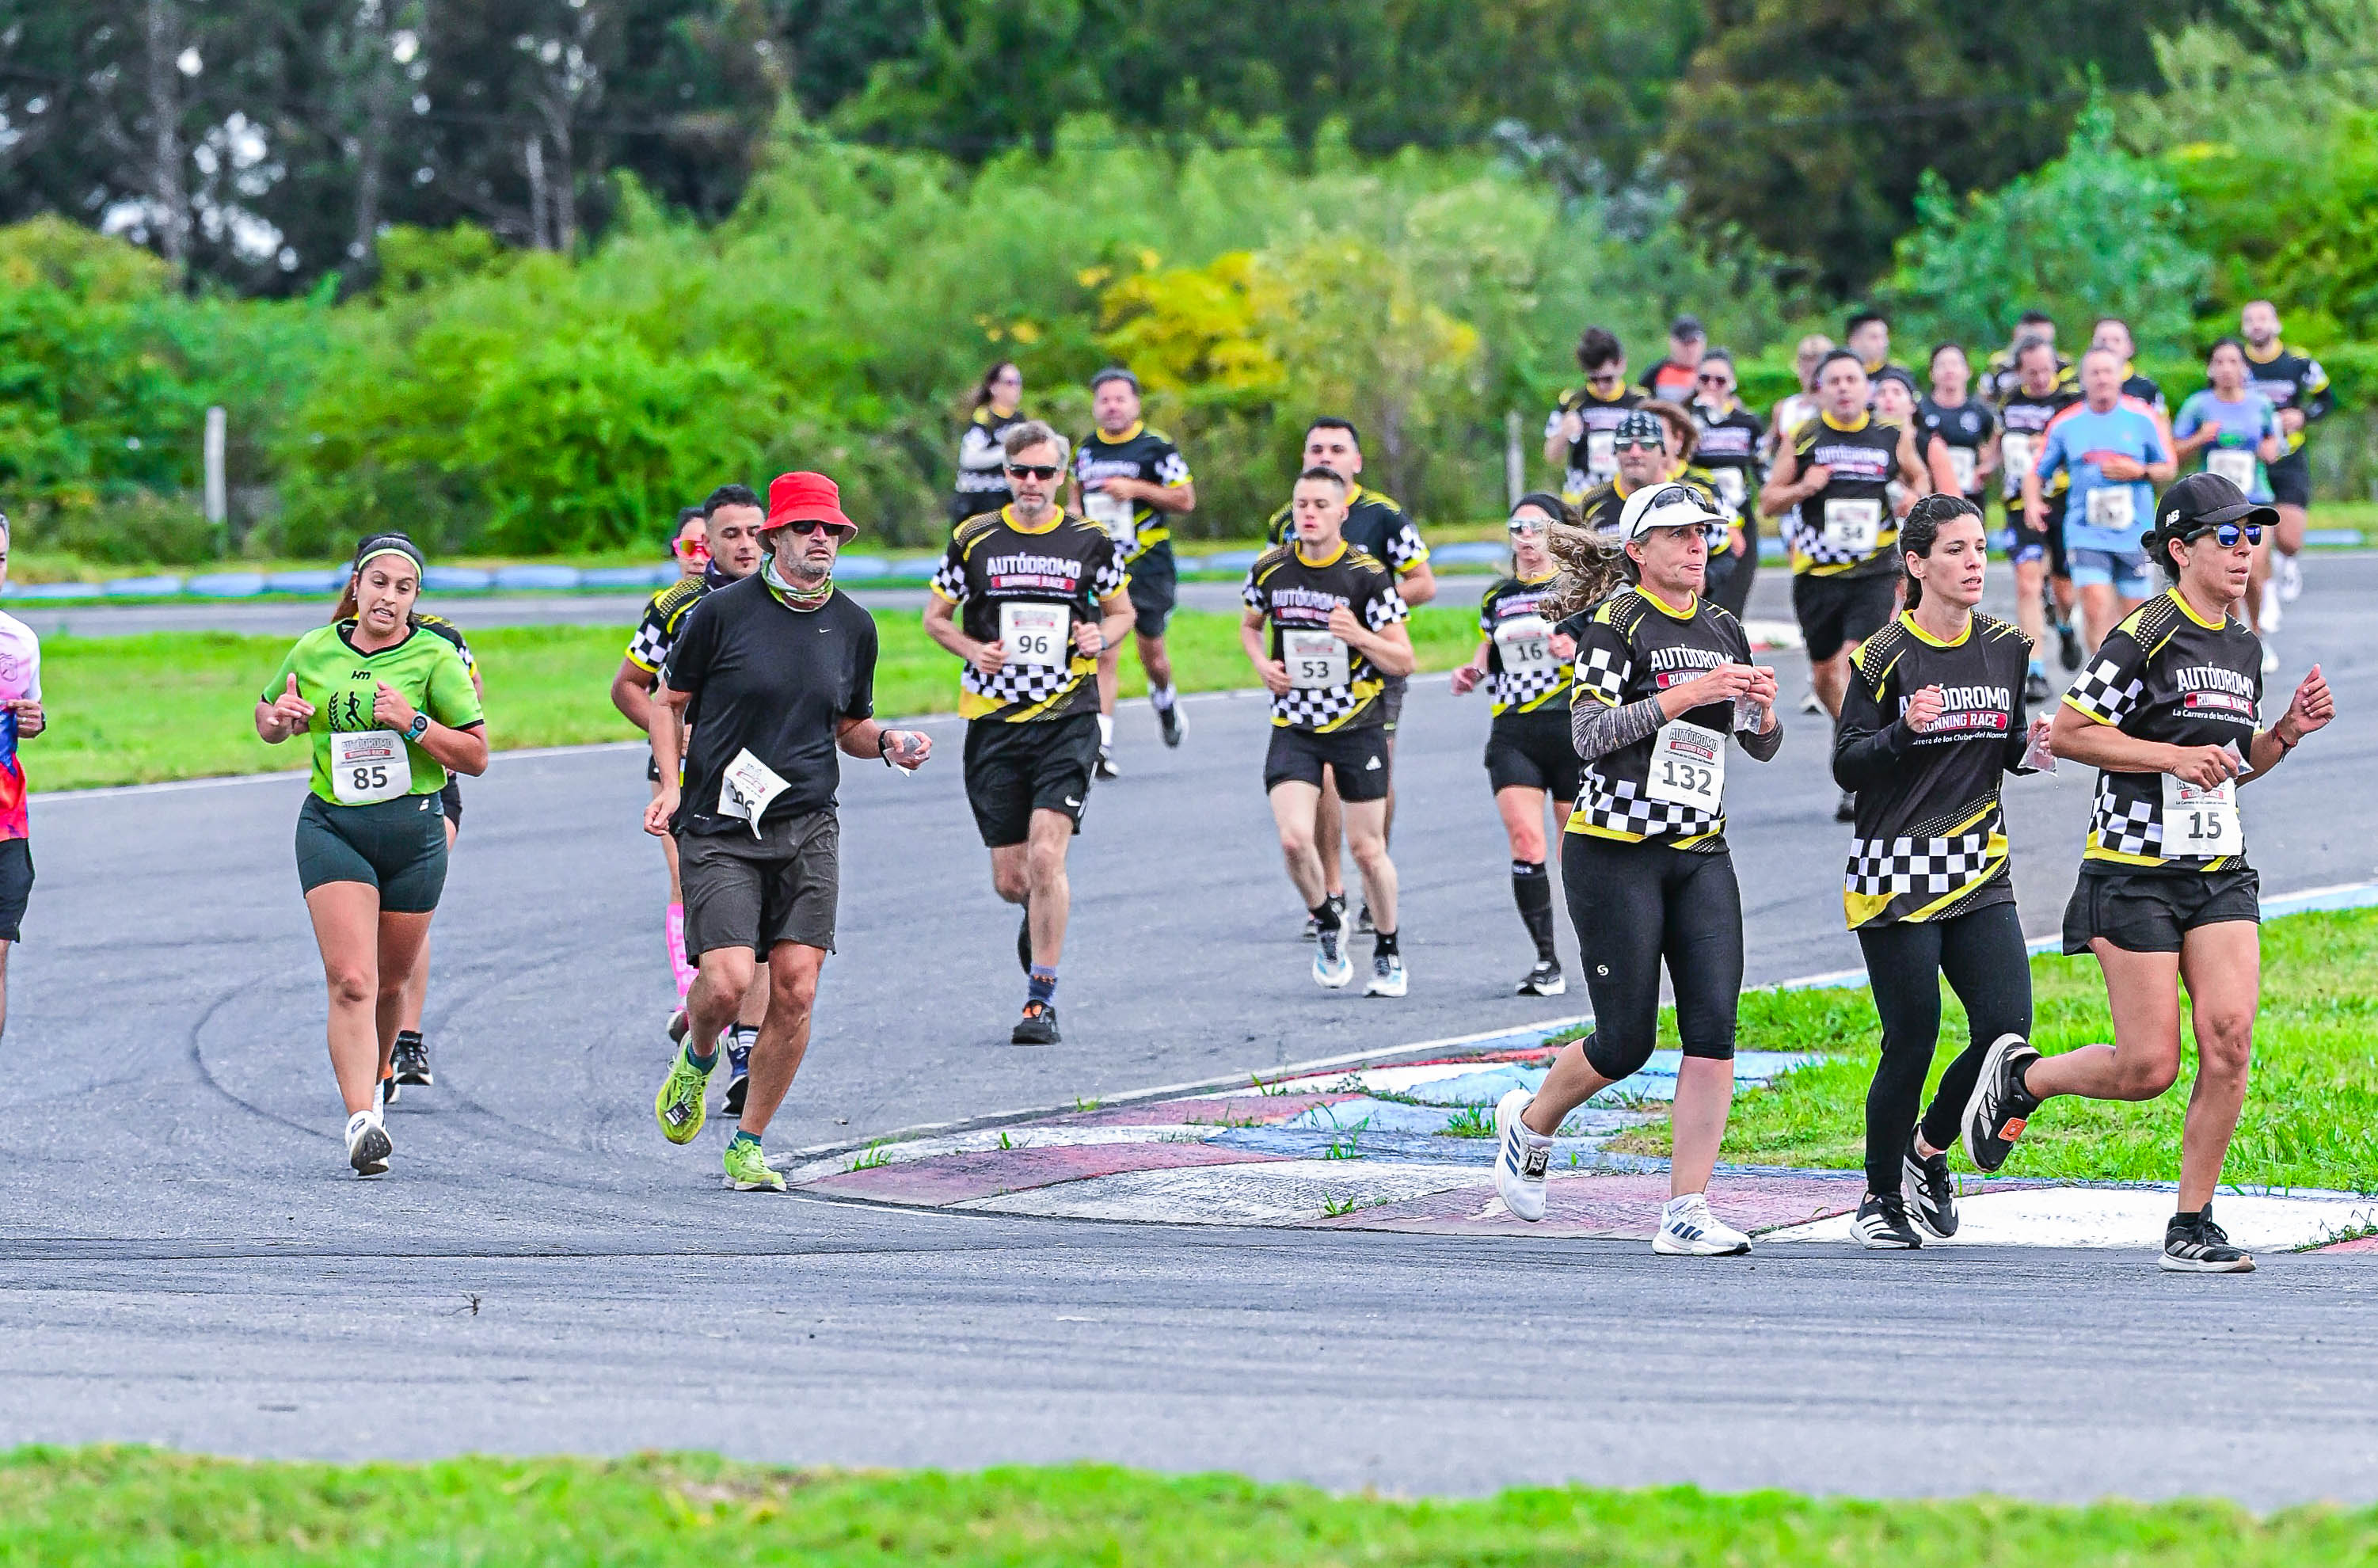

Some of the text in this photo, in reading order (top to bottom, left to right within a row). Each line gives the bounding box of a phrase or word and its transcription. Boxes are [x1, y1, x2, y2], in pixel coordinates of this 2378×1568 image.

[986, 551, 1082, 579] AUTÓDROMO
[1019, 635, 1048, 654] 96
[1518, 643, 1543, 661] 16
[1302, 660, 1329, 678] 53
[1668, 672, 1709, 687] RUNNIN
[2175, 660, 2254, 700] AUTÓDROMO
[1899, 683, 2010, 719] AÓDROMO
[1924, 713, 1998, 733] UNNING RACE
[2172, 708, 2182, 717] La
[2182, 710, 2209, 719] Carrera
[1669, 726, 1718, 752] AUTÓDROMO
[1953, 733, 1975, 741] Clube
[353, 765, 388, 790] 85
[1662, 760, 1712, 797] 132
[2188, 811, 2222, 839] 15
